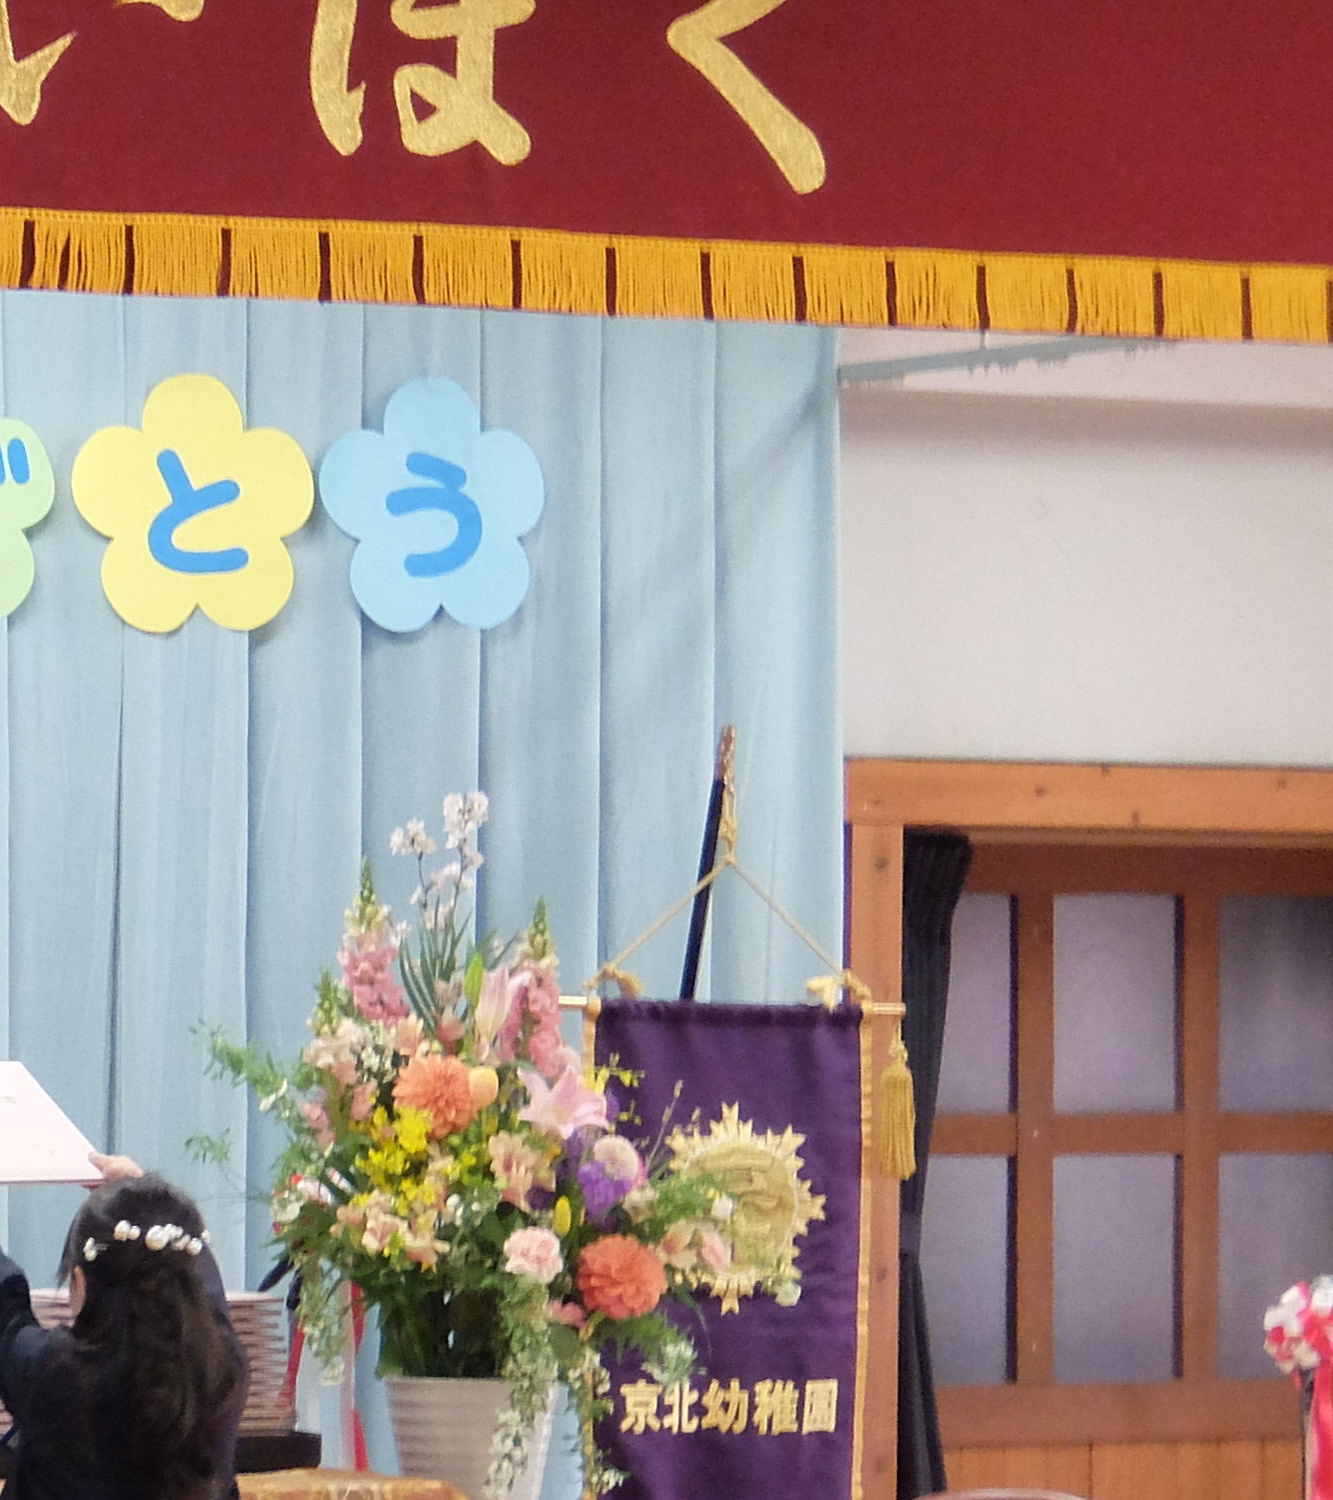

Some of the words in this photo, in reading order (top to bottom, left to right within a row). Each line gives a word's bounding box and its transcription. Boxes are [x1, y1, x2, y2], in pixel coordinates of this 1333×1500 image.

[619, 1377, 839, 1436] 京北幼稚園
